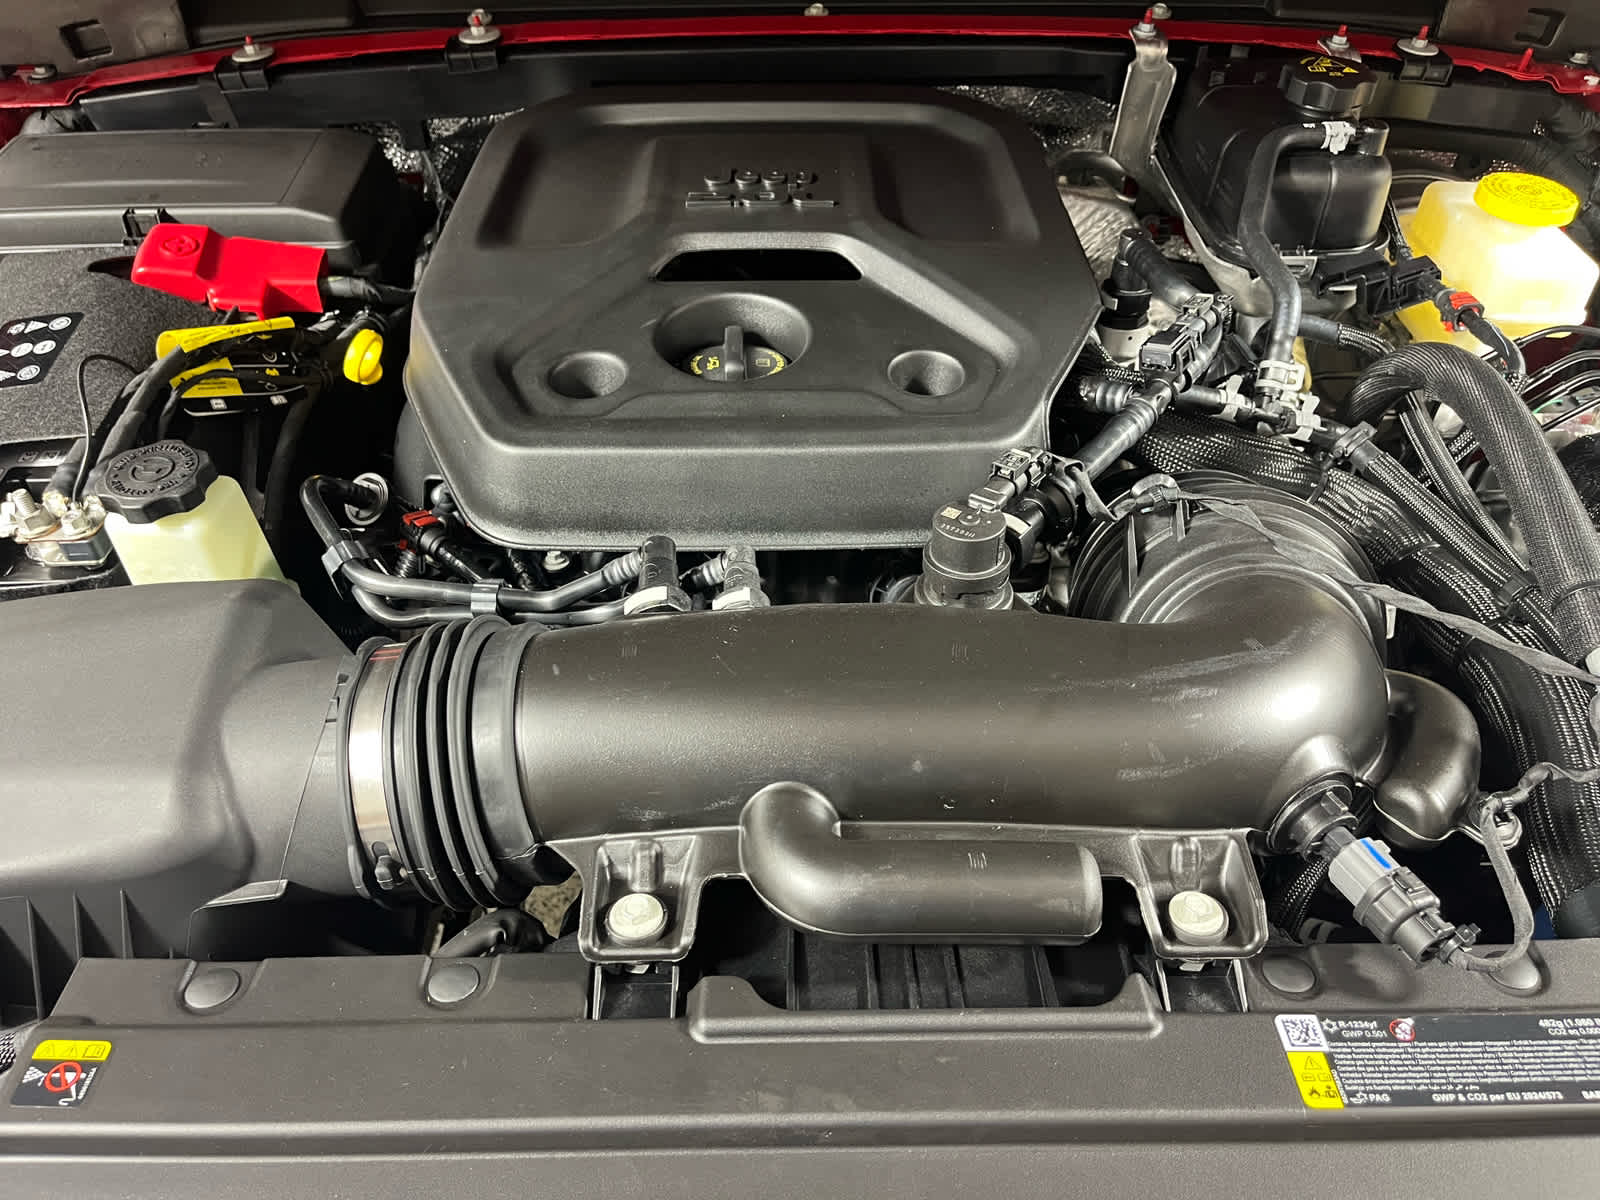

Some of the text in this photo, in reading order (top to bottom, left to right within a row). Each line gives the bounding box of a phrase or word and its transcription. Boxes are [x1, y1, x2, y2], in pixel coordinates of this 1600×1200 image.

[703, 168, 816, 193] Jeep
[1338, 1020, 1378, 1030] R-1234yf
[1341, 1030, 1388, 1039] GWP 0.501
[1548, 1027, 1568, 1036] CO2
[1568, 1029, 1580, 1037] eq
[1368, 1093, 1391, 1103] PAG
[1431, 1093, 1455, 1103] GWP
[1457, 1093, 1466, 1102] &
[1467, 1092, 1488, 1102] CO2
[1489, 1094, 1505, 1103] per
[1505, 1091, 1521, 1101] EU
